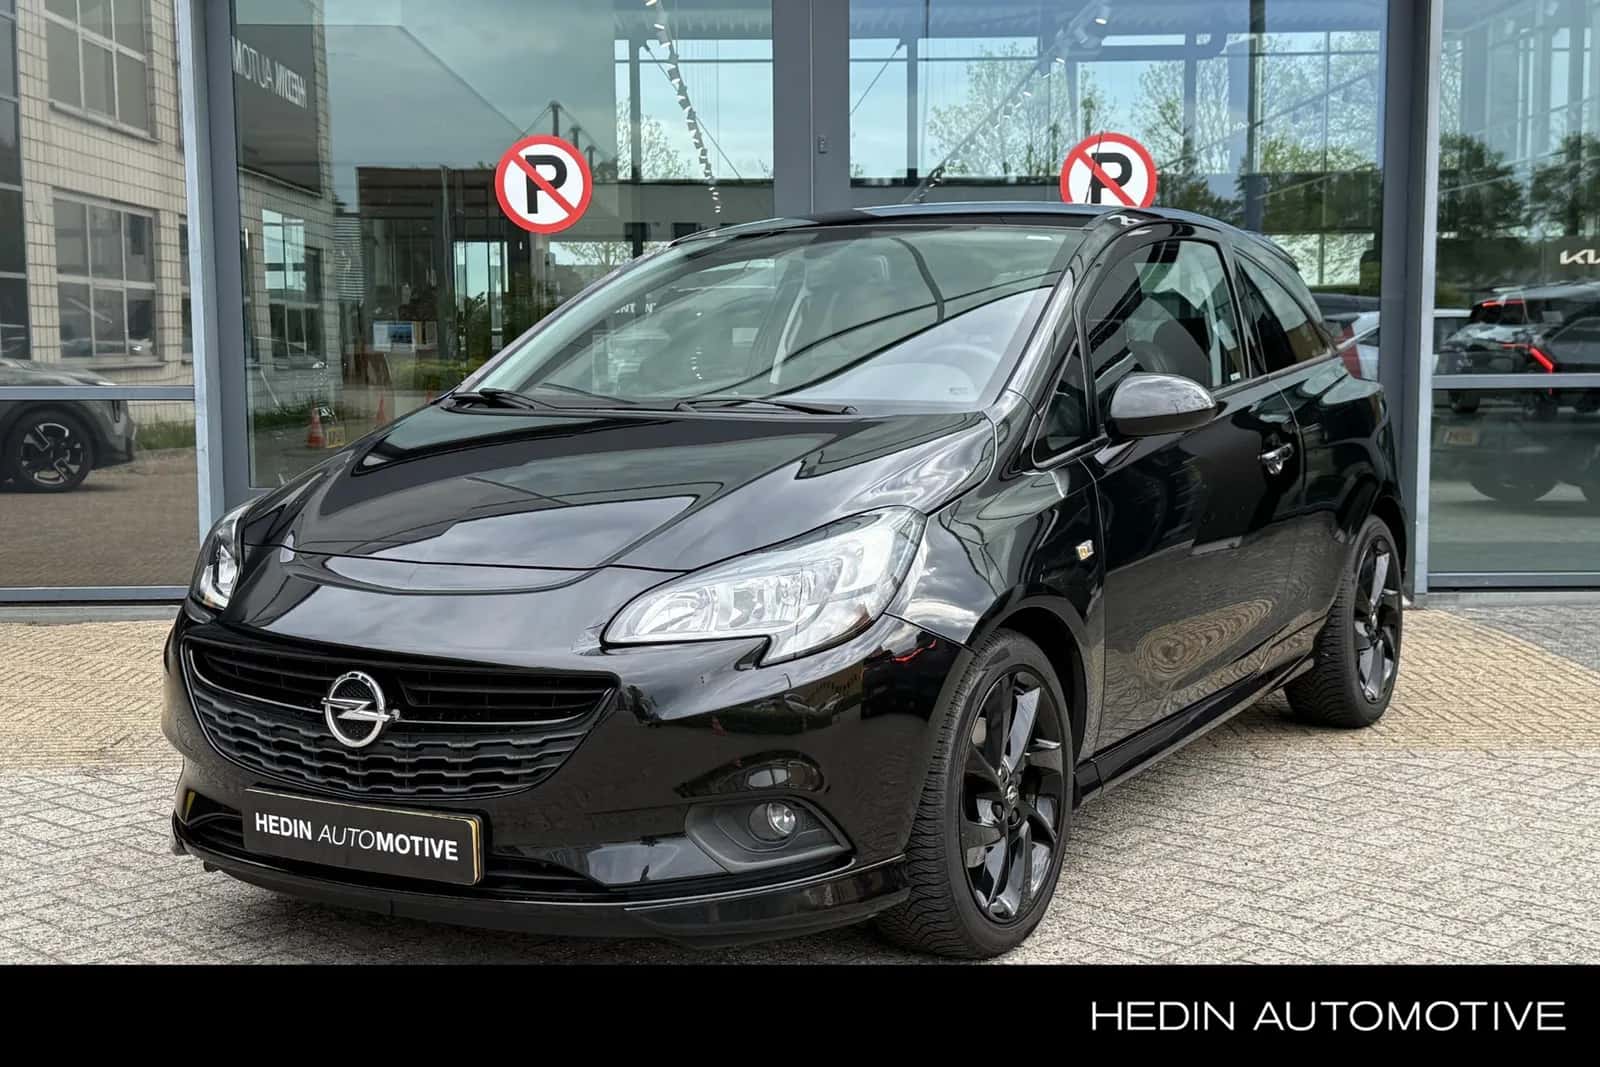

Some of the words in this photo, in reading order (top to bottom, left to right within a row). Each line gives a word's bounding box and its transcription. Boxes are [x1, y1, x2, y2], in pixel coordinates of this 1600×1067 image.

[525, 154, 567, 214] P
[1091, 152, 1132, 204] P
[1560, 249, 1600, 265] KI
[255, 812, 312, 840] HEDIN
[318, 824, 458, 861] AUTOMOTIVE
